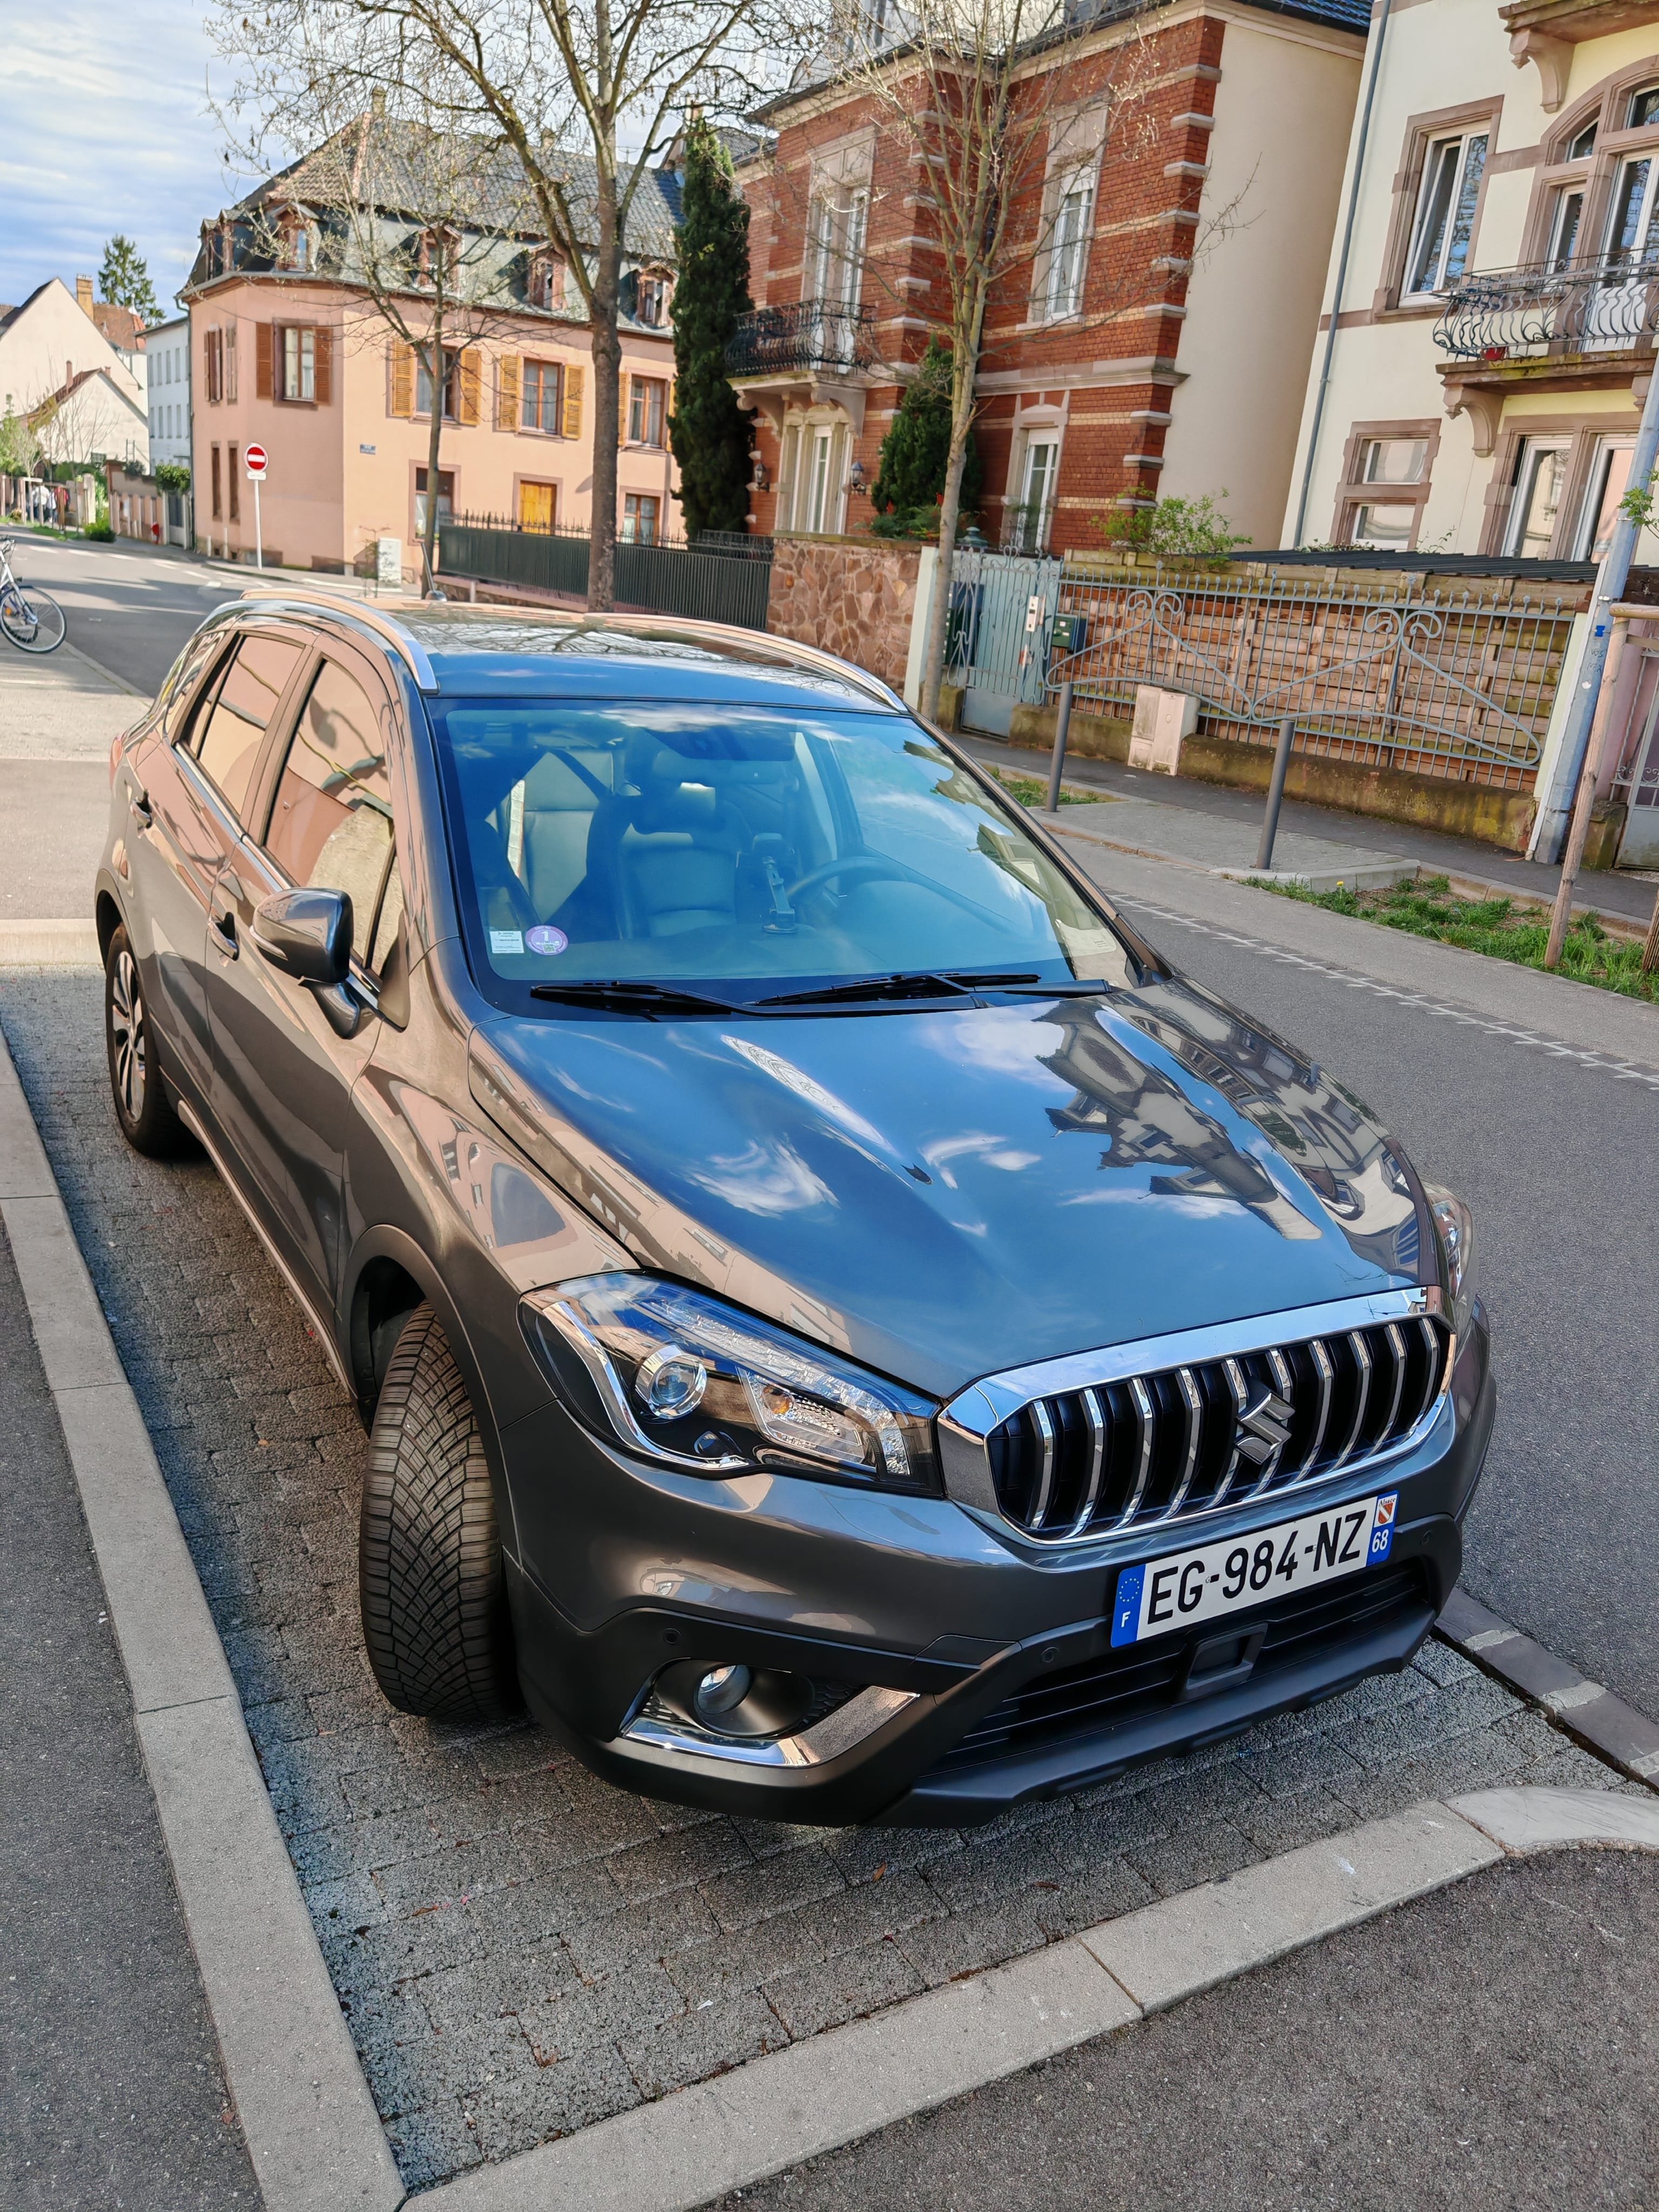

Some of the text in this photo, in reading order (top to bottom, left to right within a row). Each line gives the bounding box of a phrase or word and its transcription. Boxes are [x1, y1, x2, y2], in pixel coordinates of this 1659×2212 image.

[541, 930, 549, 941] 1
[1379, 1498, 1396, 1507] Alsace
[1372, 1529, 1389, 1553] 68
[1148, 1509, 1367, 1624] EG-984-NZ
[1121, 1611, 1131, 1628] F
